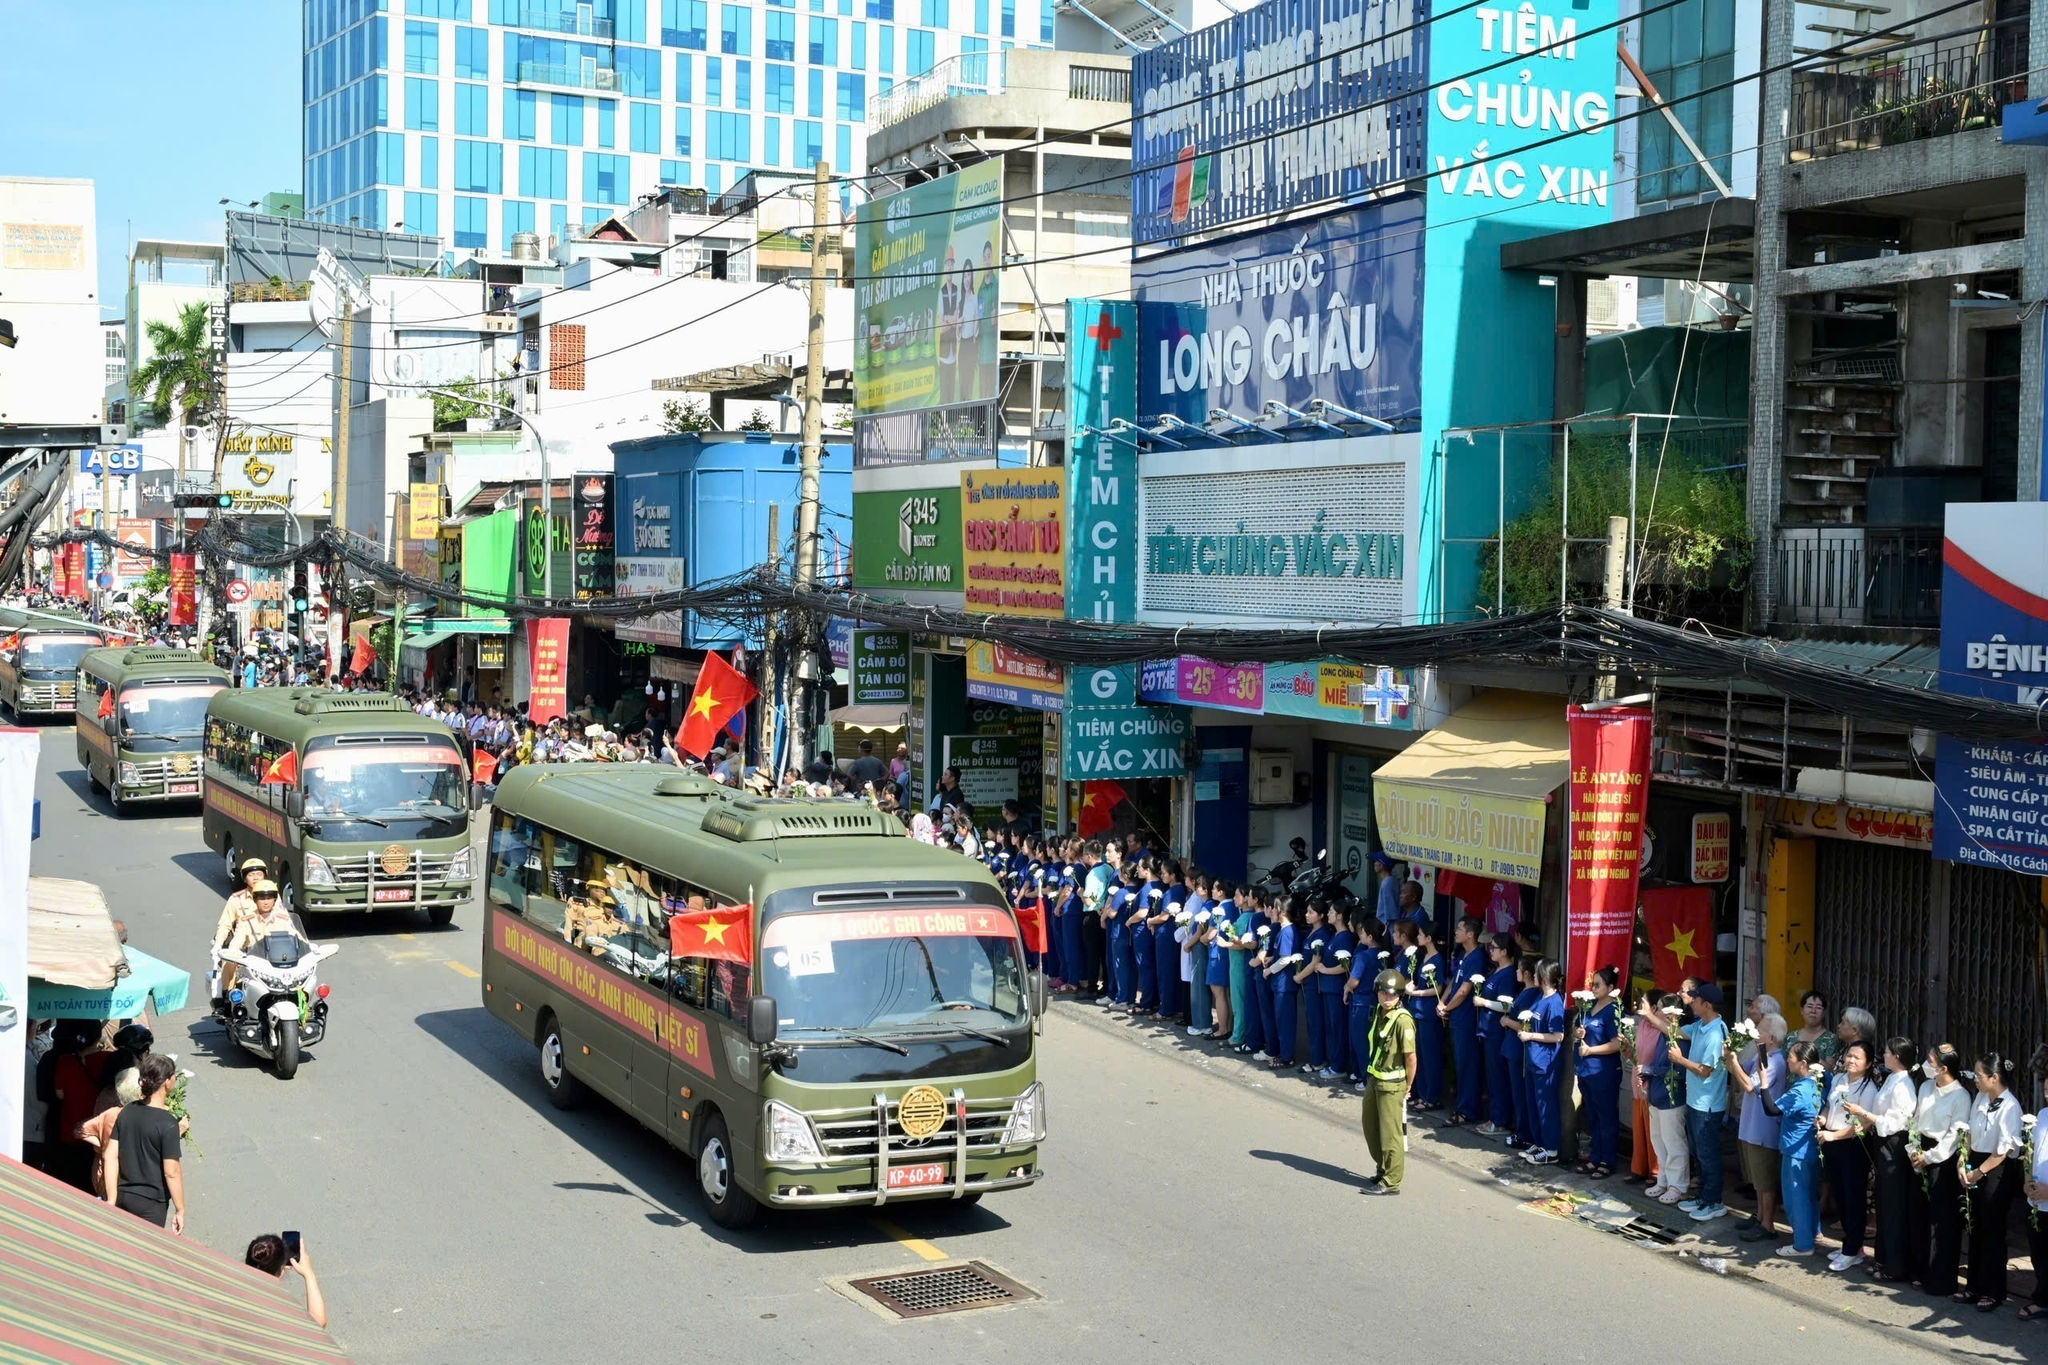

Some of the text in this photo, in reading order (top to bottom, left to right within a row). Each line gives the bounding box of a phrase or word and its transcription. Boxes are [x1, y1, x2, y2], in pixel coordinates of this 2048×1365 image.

[1475, 1, 1577, 60] TIÊM
[1144, 71, 1201, 141] CÔNG
[1210, 58, 1238, 119] TY
[1245, 28, 1315, 107] DƯỢC
[1437, 69, 1609, 135] CHỦNG
[1222, 98, 1391, 200] FPT PHARMA
[1435, 139, 1608, 207] VẮC XIN
[974, 180, 998, 198] ICLOUD
[895, 198, 911, 218] 345
[1201, 233, 1326, 307] NHÀ THUỐC
[1160, 291, 1378, 395] LONG CHÂU
[255, 431, 292, 453] KÍNH
[1091, 365, 1119, 506] TIÊM
[86, 449, 140, 469] ACB
[913, 497, 938, 525] 345
[913, 534, 936, 547] MONEY
[965, 519, 996, 552] GAS
[1147, 508, 1404, 580] TIÊM CHỦNG VẮC XIN
[885, 557, 903, 581] CẦM
[919, 561, 935, 587] TẬN
[936, 562, 950, 583] NƠI
[252, 574, 284, 601] MẮT
[251, 604, 285, 628] KÍNH
[625, 642, 656, 655] HAS
[877, 635, 898, 645] 345
[482, 652, 504, 665] NHẬT
[858, 653, 906, 668] CẦM ĐỒ
[1966, 633, 2048, 678] BỆNH
[858, 671, 906, 687] TẬN NƠI
[1192, 666, 1216, 695] 25%
[1293, 669, 1315, 696] BẦU
[1320, 667, 1337, 677] LONG
[1236, 670, 1262, 701] 30%
[1076, 714, 1185, 737] TIÊM CHỦNG
[981, 739, 997, 749] 345
[1077, 738, 1185, 772] VẮC XIN
[1971, 746, 2013, 763] KHÁM
[951, 755, 970, 767] CẦM
[985, 756, 1001, 768] TẬN
[1003, 756, 1017, 767] NƠI
[1572, 766, 1587, 784] LỄ
[1970, 765, 2026, 784] SIÊU ÂM
[1969, 785, 2040, 805] CUNG CẤP
[1377, 791, 1540, 858] ĐẬU HŨ BẮC NINH
[1969, 804, 2038, 825] NHẬN GIỮ
[1623, 831, 1633, 842] DO
[1696, 821, 1715, 842] ĐẬU
[1968, 823, 2048, 847] SPA CẮT TỈA
[1711, 846, 1729, 862] NINH
[1959, 846, 2048, 872] Địa Chỉ: 416 Cách
[1457, 853, 1469, 868] P.11
[1473, 857, 1483, 871] Q.3
[1499, 860, 1515, 876] 0909
[1516, 864, 1528, 878] 579
[893, 914, 921, 933] GHI
[923, 911, 967, 933] CÔNG
[801, 951, 821, 968] 05
[505, 925, 699, 1058] ĐỜI ĐỜI NHỚ ƠN CÁC ANH HÙNG LIỆT SĨ
[37, 994, 134, 1012] AN TOÀN TUYỆT ĐỐI
[889, 1165, 942, 1187] KP-60-99
